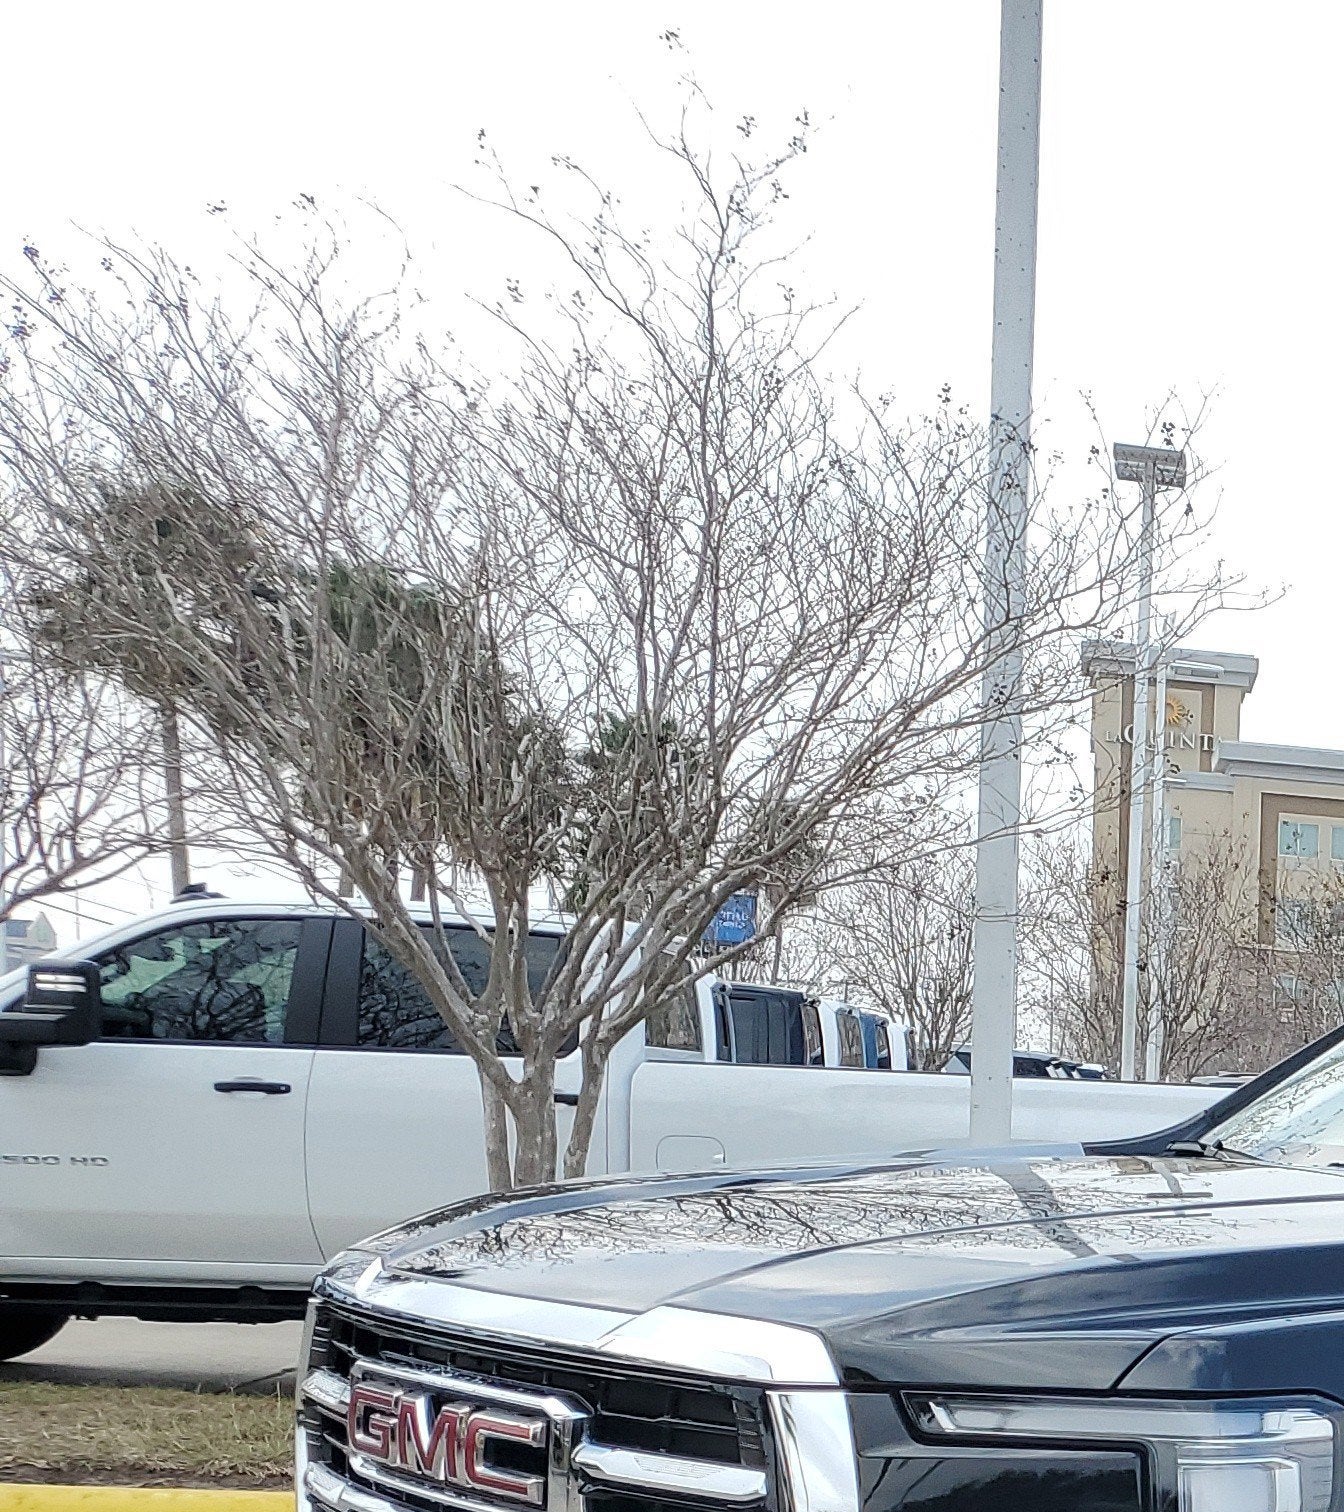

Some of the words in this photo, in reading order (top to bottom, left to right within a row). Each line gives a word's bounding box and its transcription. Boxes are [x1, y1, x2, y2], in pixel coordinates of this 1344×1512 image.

[0, 1154, 60, 1165] 500
[70, 1156, 109, 1167] HD
[348, 1380, 547, 1505] GMC
